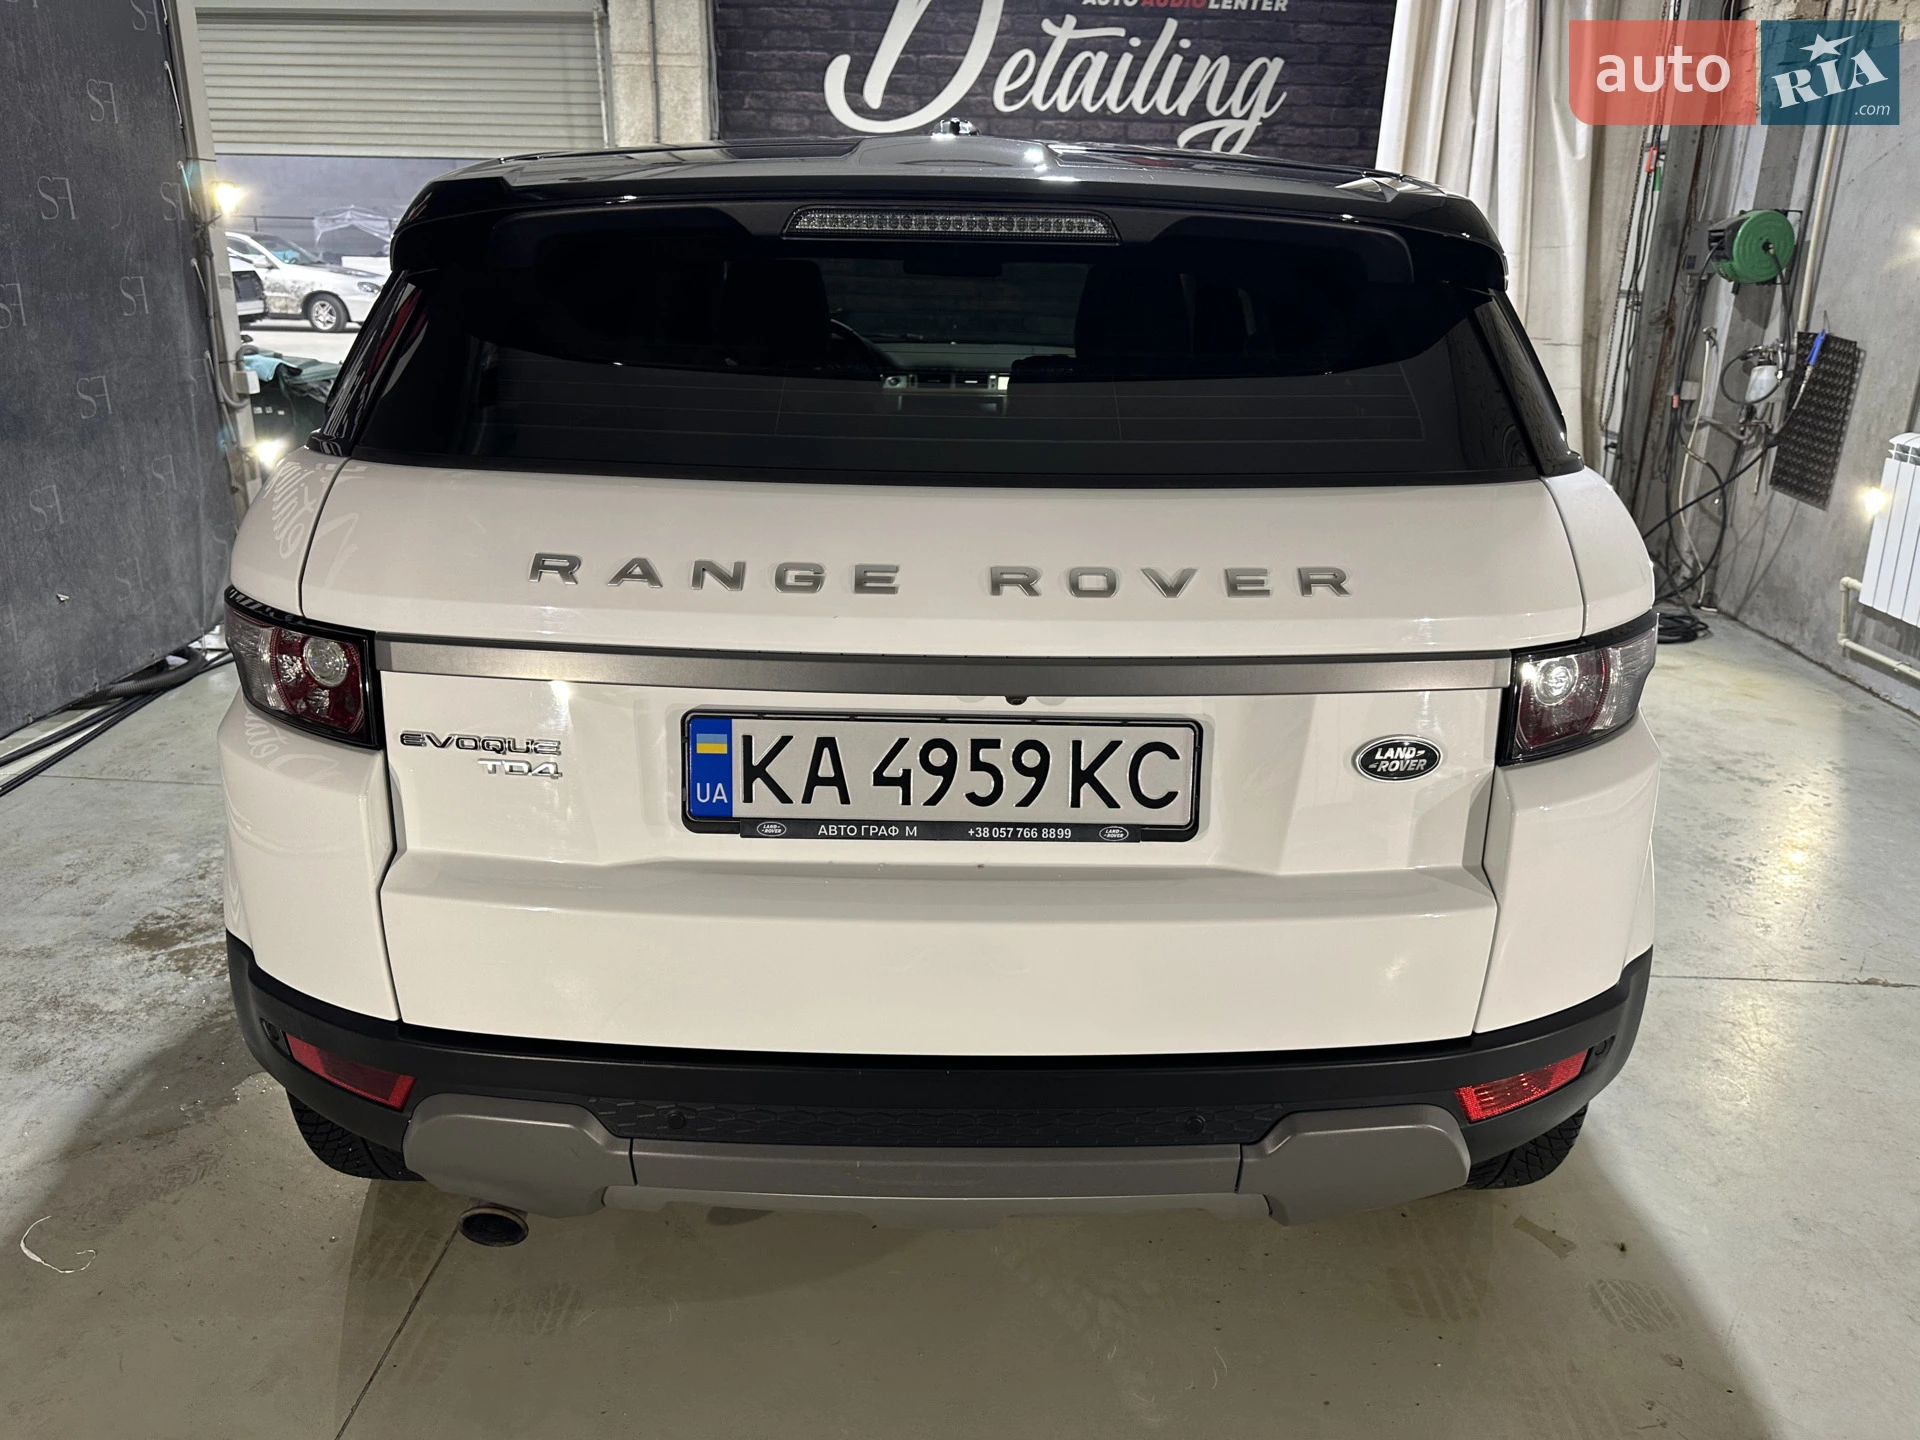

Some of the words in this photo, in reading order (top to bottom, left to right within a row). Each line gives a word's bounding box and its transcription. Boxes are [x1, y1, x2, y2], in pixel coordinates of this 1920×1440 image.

[823, 0, 1288, 154] Detailing
[529, 552, 900, 595] RANGE
[990, 566, 1351, 598] ROVER
[400, 730, 563, 756] EVOQUE
[1374, 747, 1417, 760] LAND
[476, 758, 563, 780] TD4
[742, 735, 851, 805] KA
[871, 737, 1051, 807] 4959
[1069, 740, 1181, 809] KC
[1376, 759, 1428, 772] ROVER
[696, 782, 728, 804] UA
[817, 824, 857, 837] АВТО
[861, 824, 899, 837] ГРАФ
[967, 827, 990, 838] +38
[992, 827, 1014, 838] 057
[1016, 827, 1038, 838] 766
[1041, 828, 1072, 839] 8899
